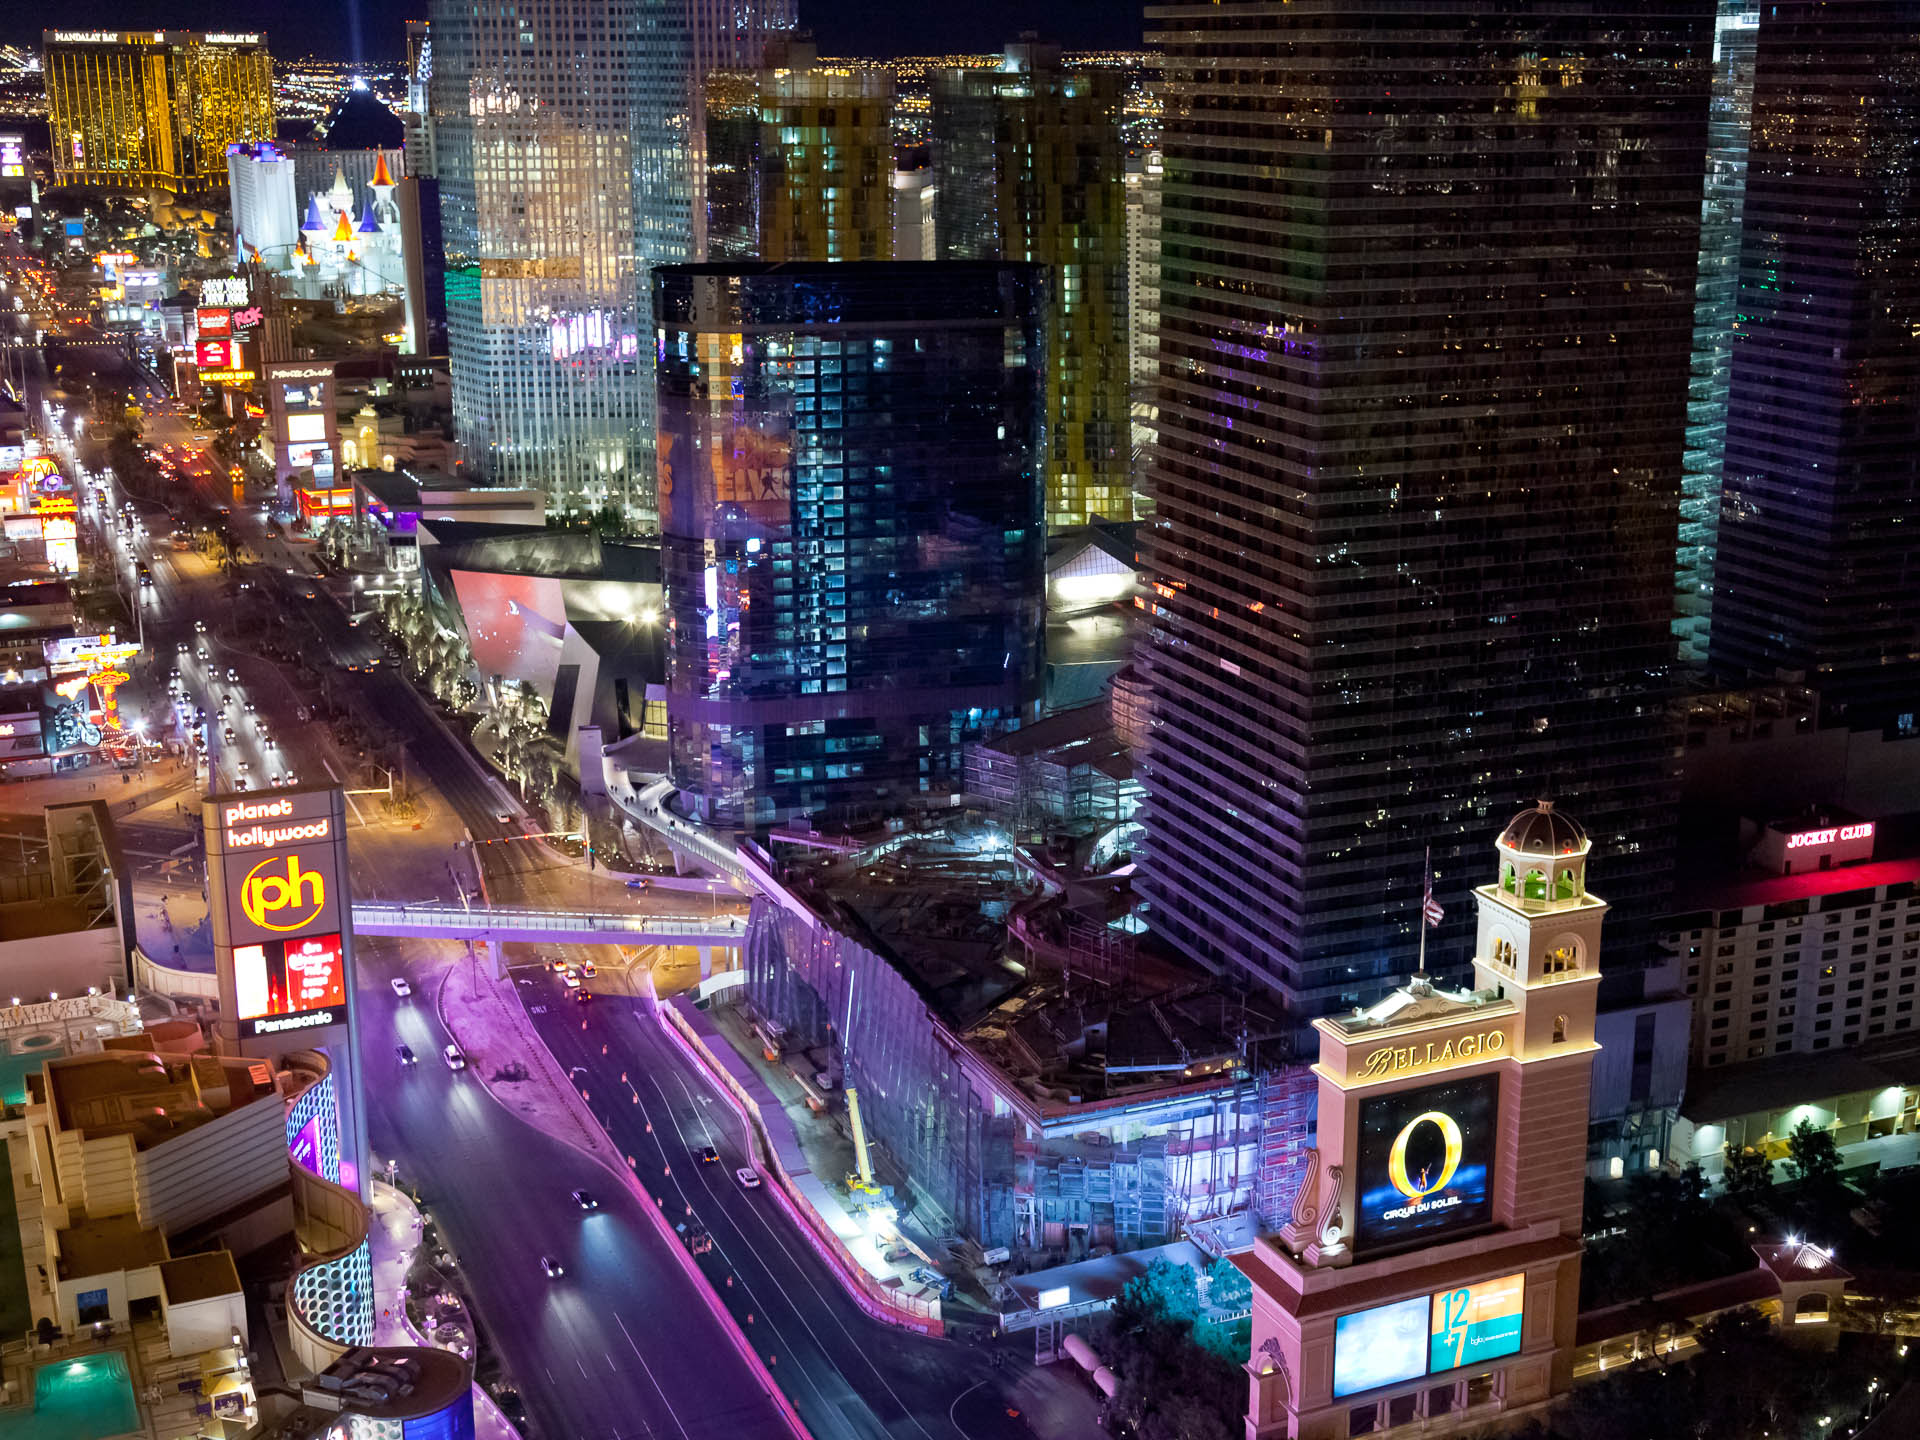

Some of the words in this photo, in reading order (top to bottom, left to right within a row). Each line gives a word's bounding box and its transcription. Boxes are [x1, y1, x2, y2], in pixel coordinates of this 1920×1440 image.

[55, 32, 101, 42] MANDALAY
[102, 33, 118, 42] BAY
[205, 34, 244, 43] MANDALAY
[245, 34, 259, 44] BAY
[202, 279, 225, 292] NEW
[225, 278, 248, 292] YORK
[233, 306, 264, 331] ROK
[235, 370, 256, 380] BEER
[272, 369, 303, 380] Monte
[303, 367, 333, 378] Carlo
[226, 799, 293, 827] planet
[228, 819, 329, 849] hollywood
[1787, 829, 1838, 848] JOCKEY
[1840, 823, 1873, 840] CLUB
[250, 855, 325, 927] ph
[254, 1010, 333, 1035] Panasonic
[1356, 1030, 1506, 1079] BELLAGIO
[1388, 1110, 1463, 1199] O
[1383, 1204, 1416, 1221] CIRQUE
[1416, 1202, 1431, 1213] DU
[1430, 1196, 1462, 1211] SOLEIL
[1440, 1288, 1471, 1332] 12
[1443, 1325, 1469, 1369] +7
